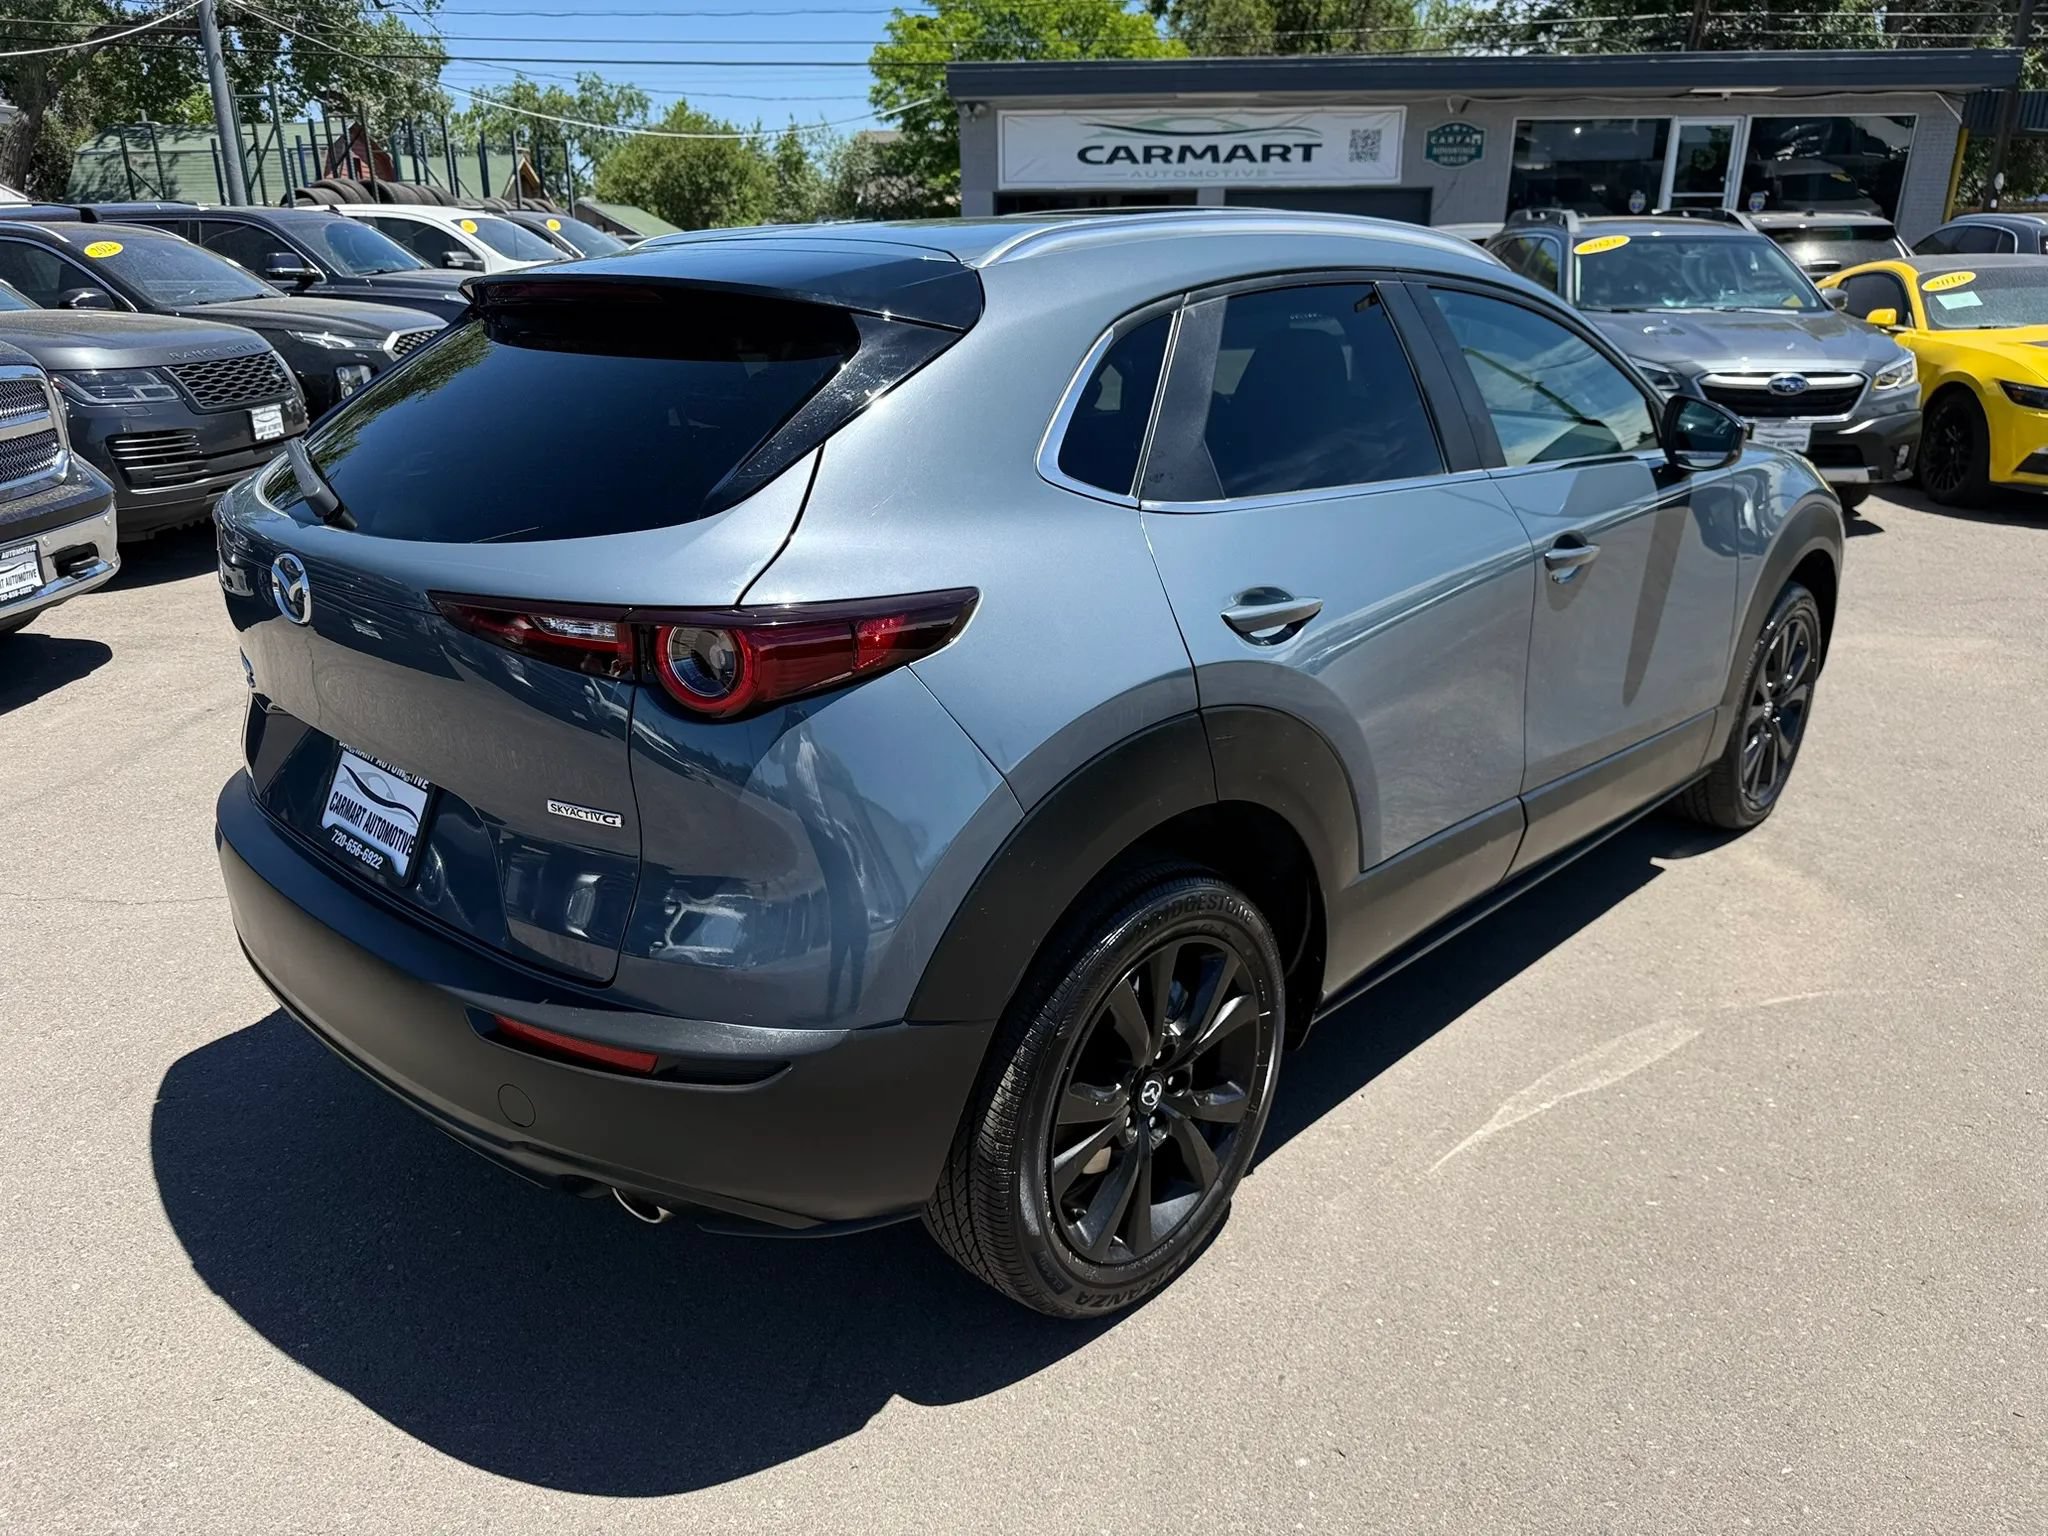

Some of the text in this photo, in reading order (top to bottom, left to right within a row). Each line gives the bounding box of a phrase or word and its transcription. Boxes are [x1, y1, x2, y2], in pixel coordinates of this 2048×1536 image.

[1077, 143, 1322, 165] CARMART
[1130, 169, 1268, 178] AUTOMOTIVE
[168, 348, 221, 361] RANGE
[1, 544, 37, 559] AUTOMOTIVE
[5, 568, 38, 586] AUTOMOTIVE
[328, 791, 416, 856] CARMART AUTOMOTIVE
[330, 828, 384, 870] 720-656-6922
